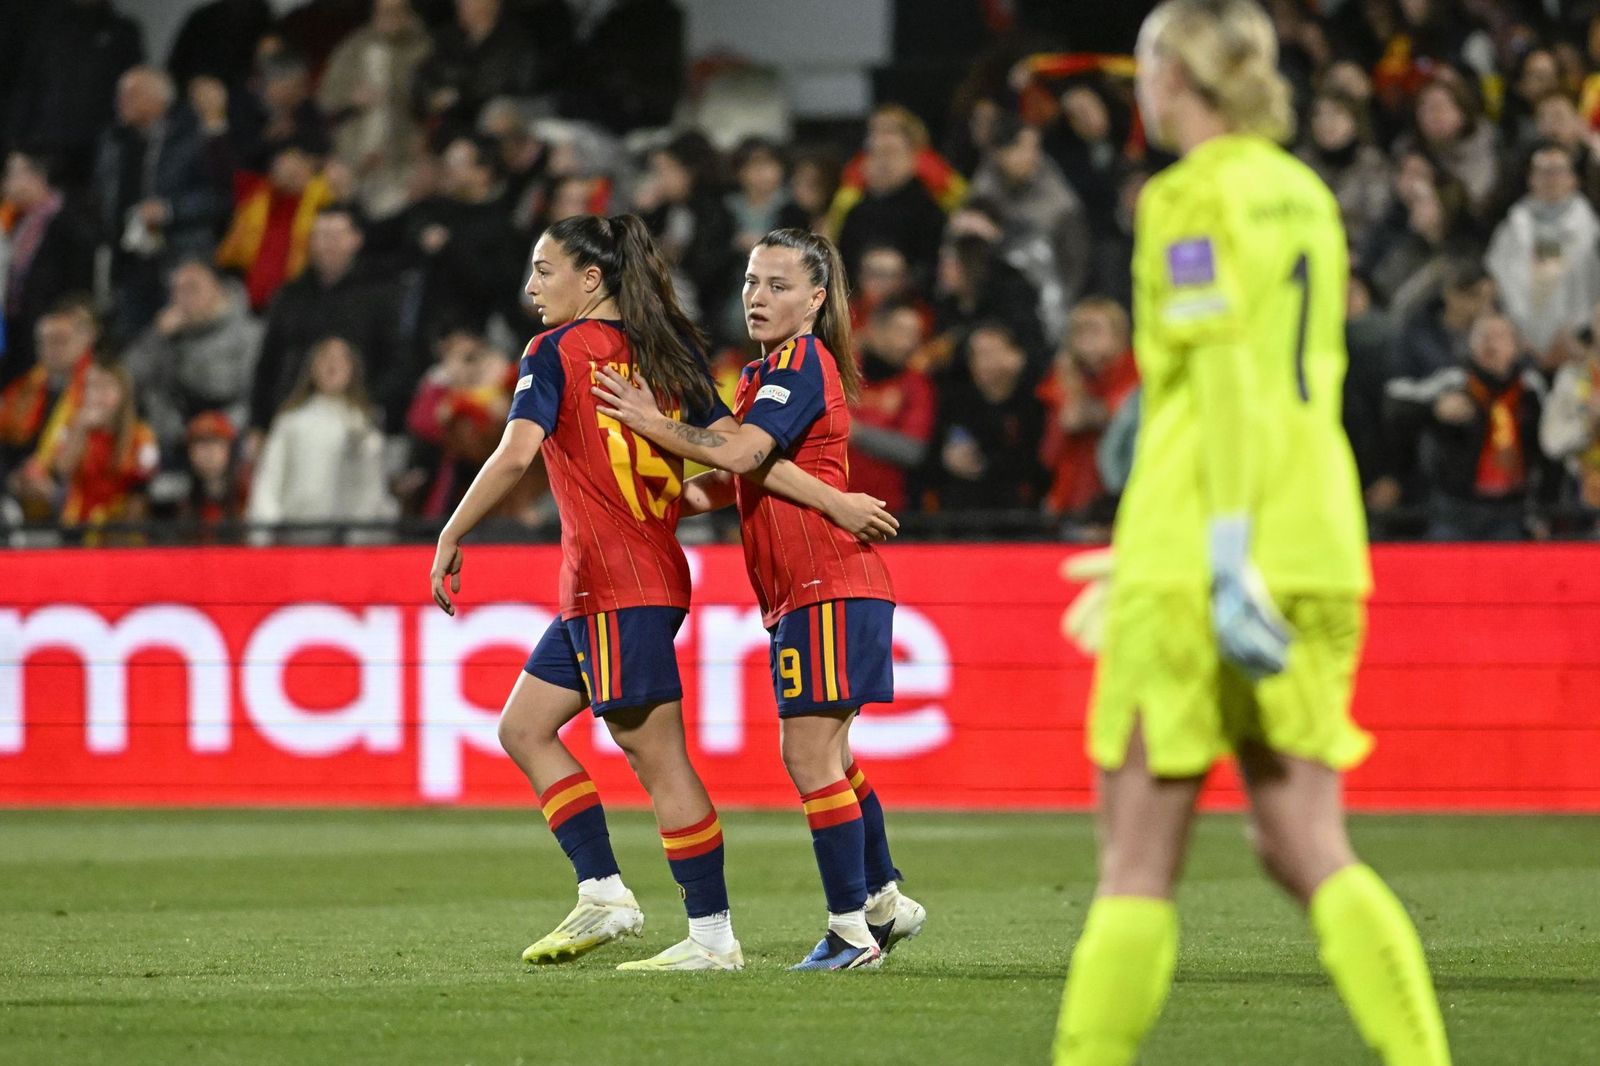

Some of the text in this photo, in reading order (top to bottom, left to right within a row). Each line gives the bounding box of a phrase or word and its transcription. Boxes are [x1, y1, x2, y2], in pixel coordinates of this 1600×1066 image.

[1288, 251, 1309, 404] 1
[596, 409, 682, 521] 15
[779, 648, 802, 698] 9
